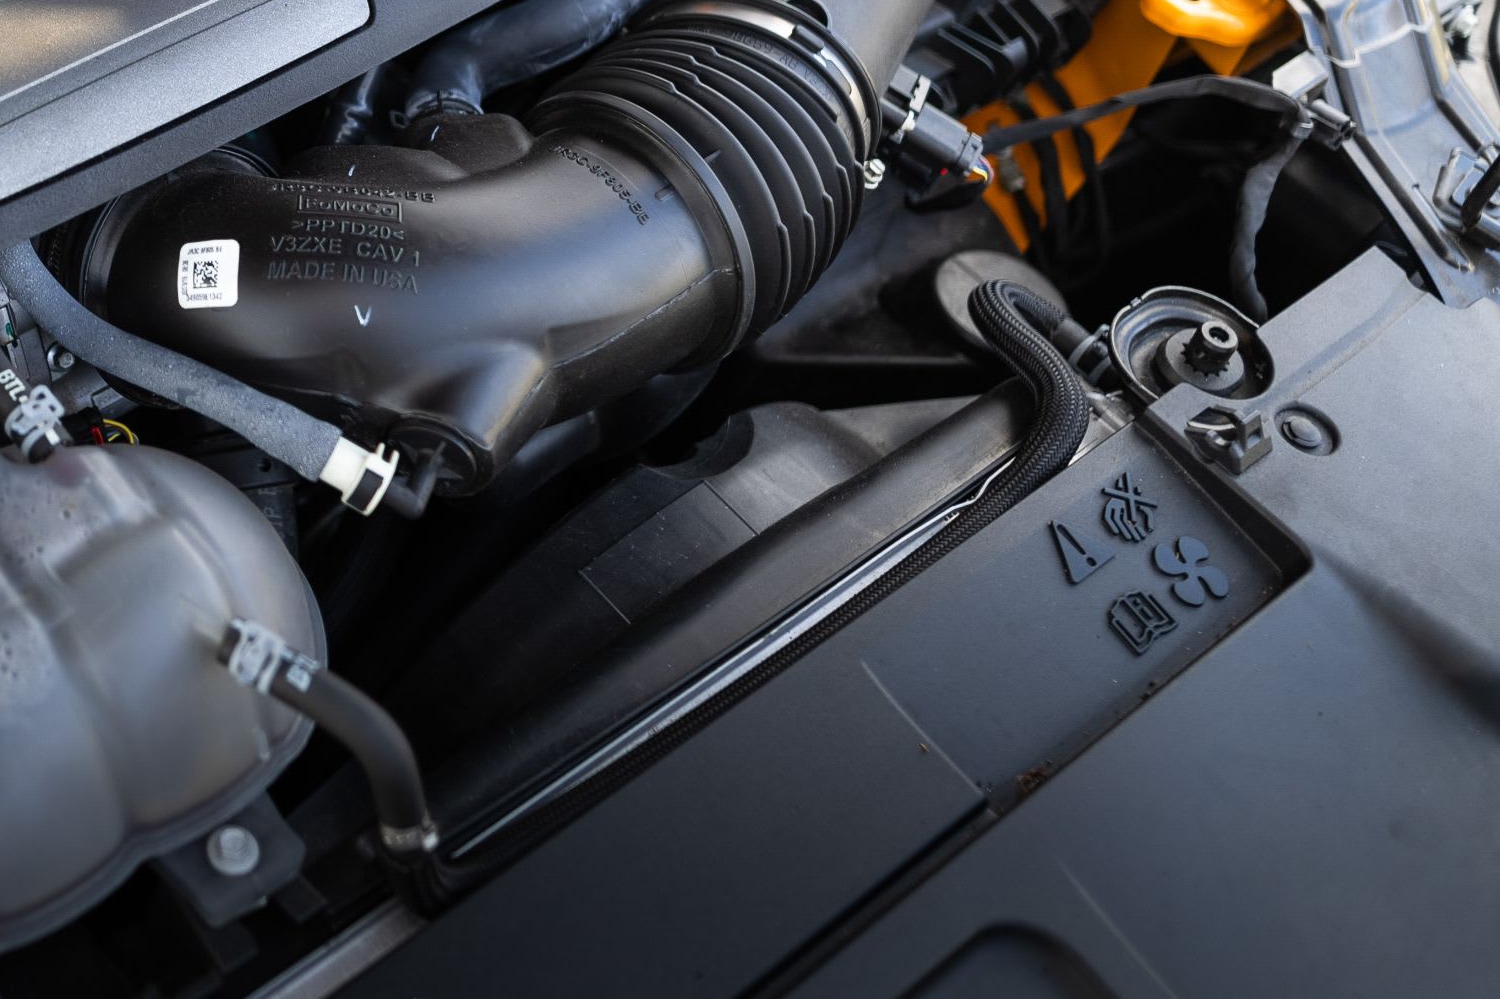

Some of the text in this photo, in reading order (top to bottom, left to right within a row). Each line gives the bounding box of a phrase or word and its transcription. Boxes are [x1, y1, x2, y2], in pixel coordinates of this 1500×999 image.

[305, 198, 395, 217] FoMoCo
[356, 241, 405, 263] CAV
[267, 260, 419, 295] MADE IN USA
